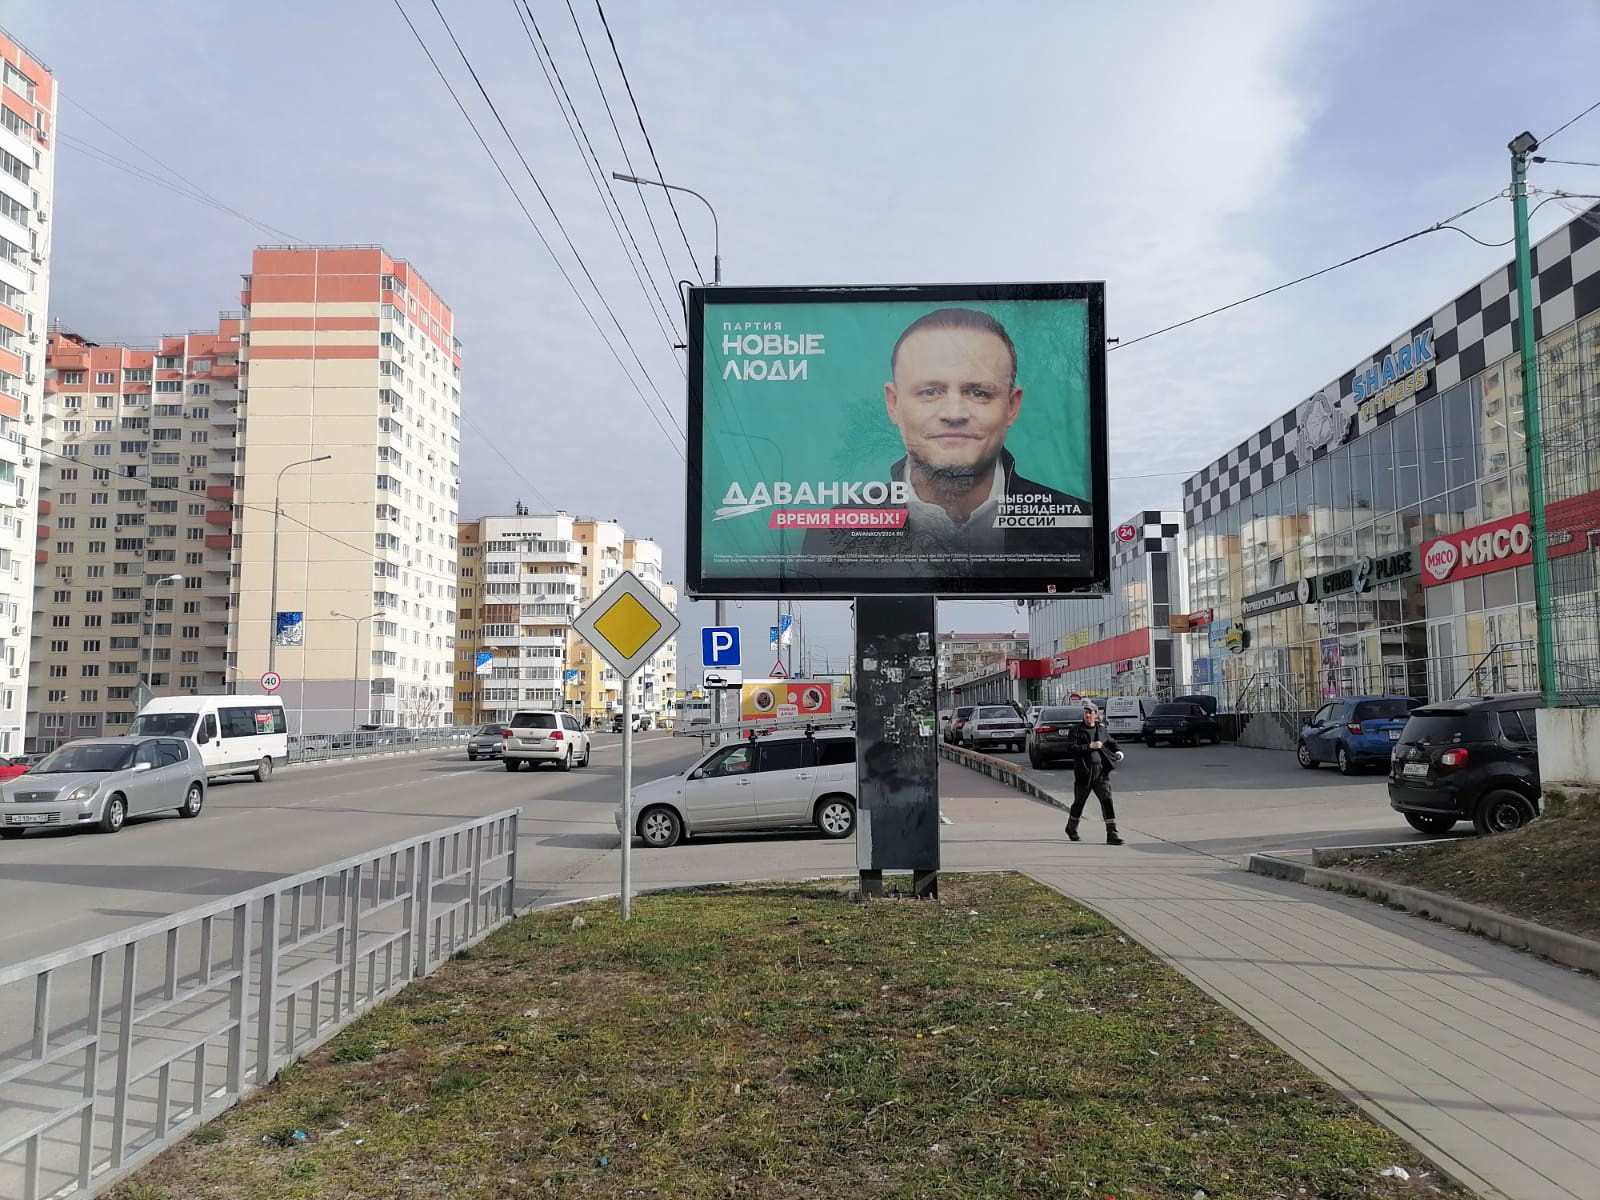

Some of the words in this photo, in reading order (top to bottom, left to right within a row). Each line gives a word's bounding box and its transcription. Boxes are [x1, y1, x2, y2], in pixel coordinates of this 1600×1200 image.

[723, 321, 782, 331] ПАРТИЯ
[722, 333, 825, 355] НОВЫЕ
[722, 359, 808, 381] ЛЮДИ
[1351, 328, 1434, 404] SHARK
[1361, 369, 1427, 421] FITNESS
[722, 481, 910, 505] ДАВАНКОВ
[998, 493, 1052, 504] ВЫБОРЫ
[776, 513, 830, 525] ВРЕМЯ
[834, 512, 900, 525] НОВЫХ!
[998, 504, 1082, 515] ПРЕЗИДЕНТА
[998, 516, 1056, 527] РОССИИ
[1120, 527, 1133, 537] 24
[1460, 523, 1531, 567] МЯСО
[1427, 549, 1453, 568] МЯСО
[1322, 570, 1352, 594] CYBER
[1375, 551, 1412, 579] PLACE
[712, 631, 733, 662] P
[264, 677, 277, 686] 40
